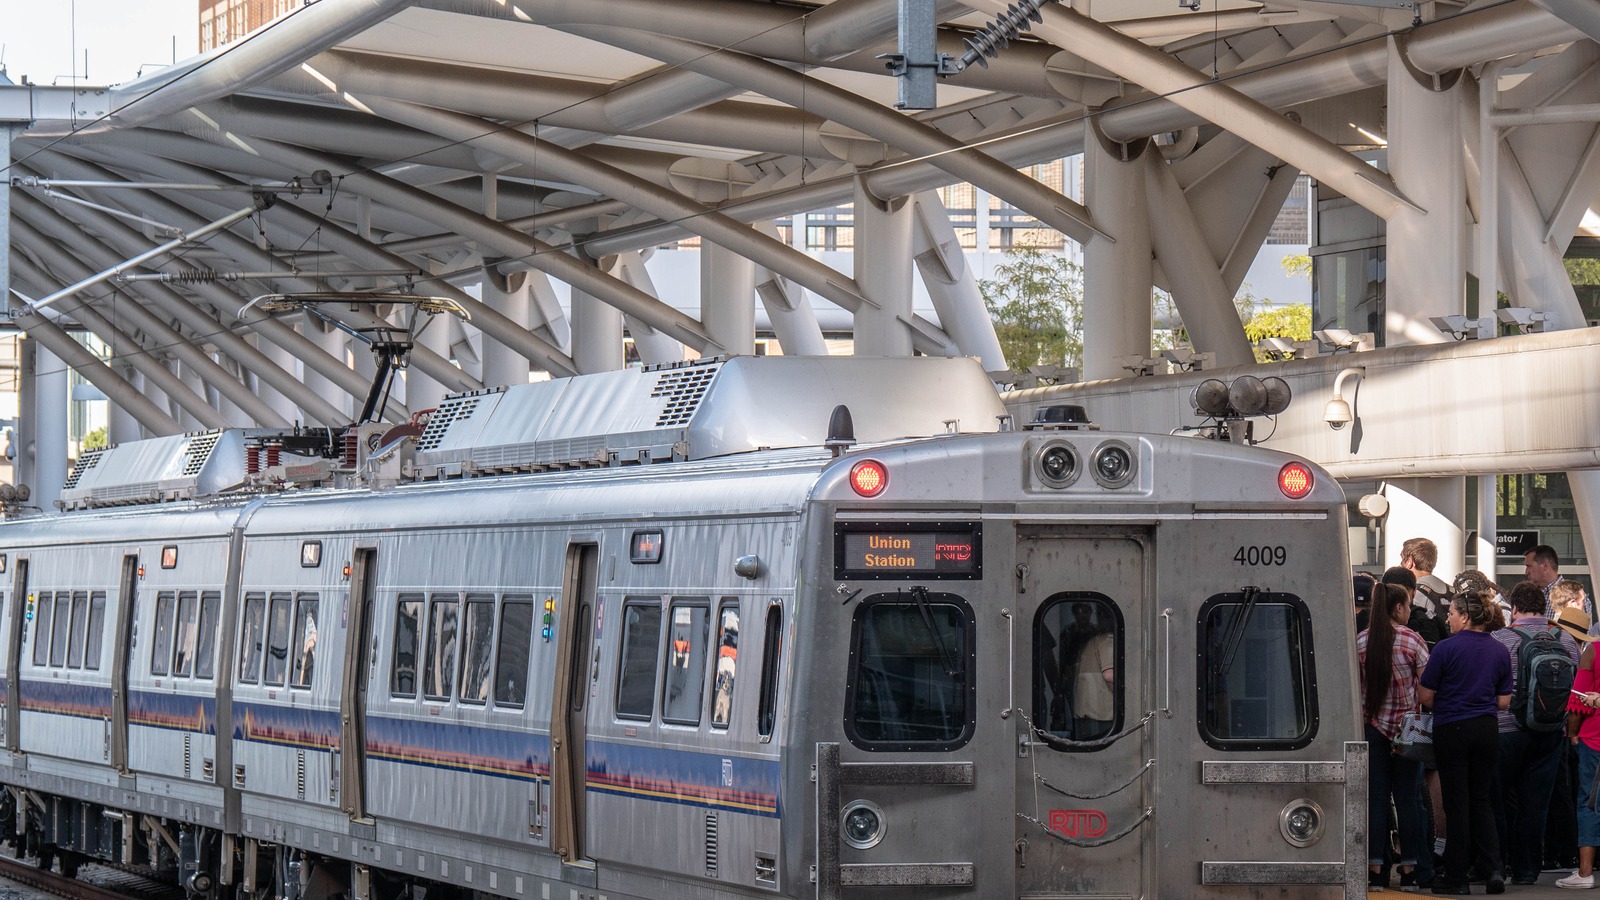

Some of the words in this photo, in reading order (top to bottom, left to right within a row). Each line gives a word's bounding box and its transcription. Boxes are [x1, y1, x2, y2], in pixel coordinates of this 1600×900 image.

[869, 535, 911, 549] Union
[865, 553, 915, 567] Station
[935, 543, 971, 560] RTD
[1233, 545, 1287, 567] 4009
[1049, 809, 1109, 838] RTD
